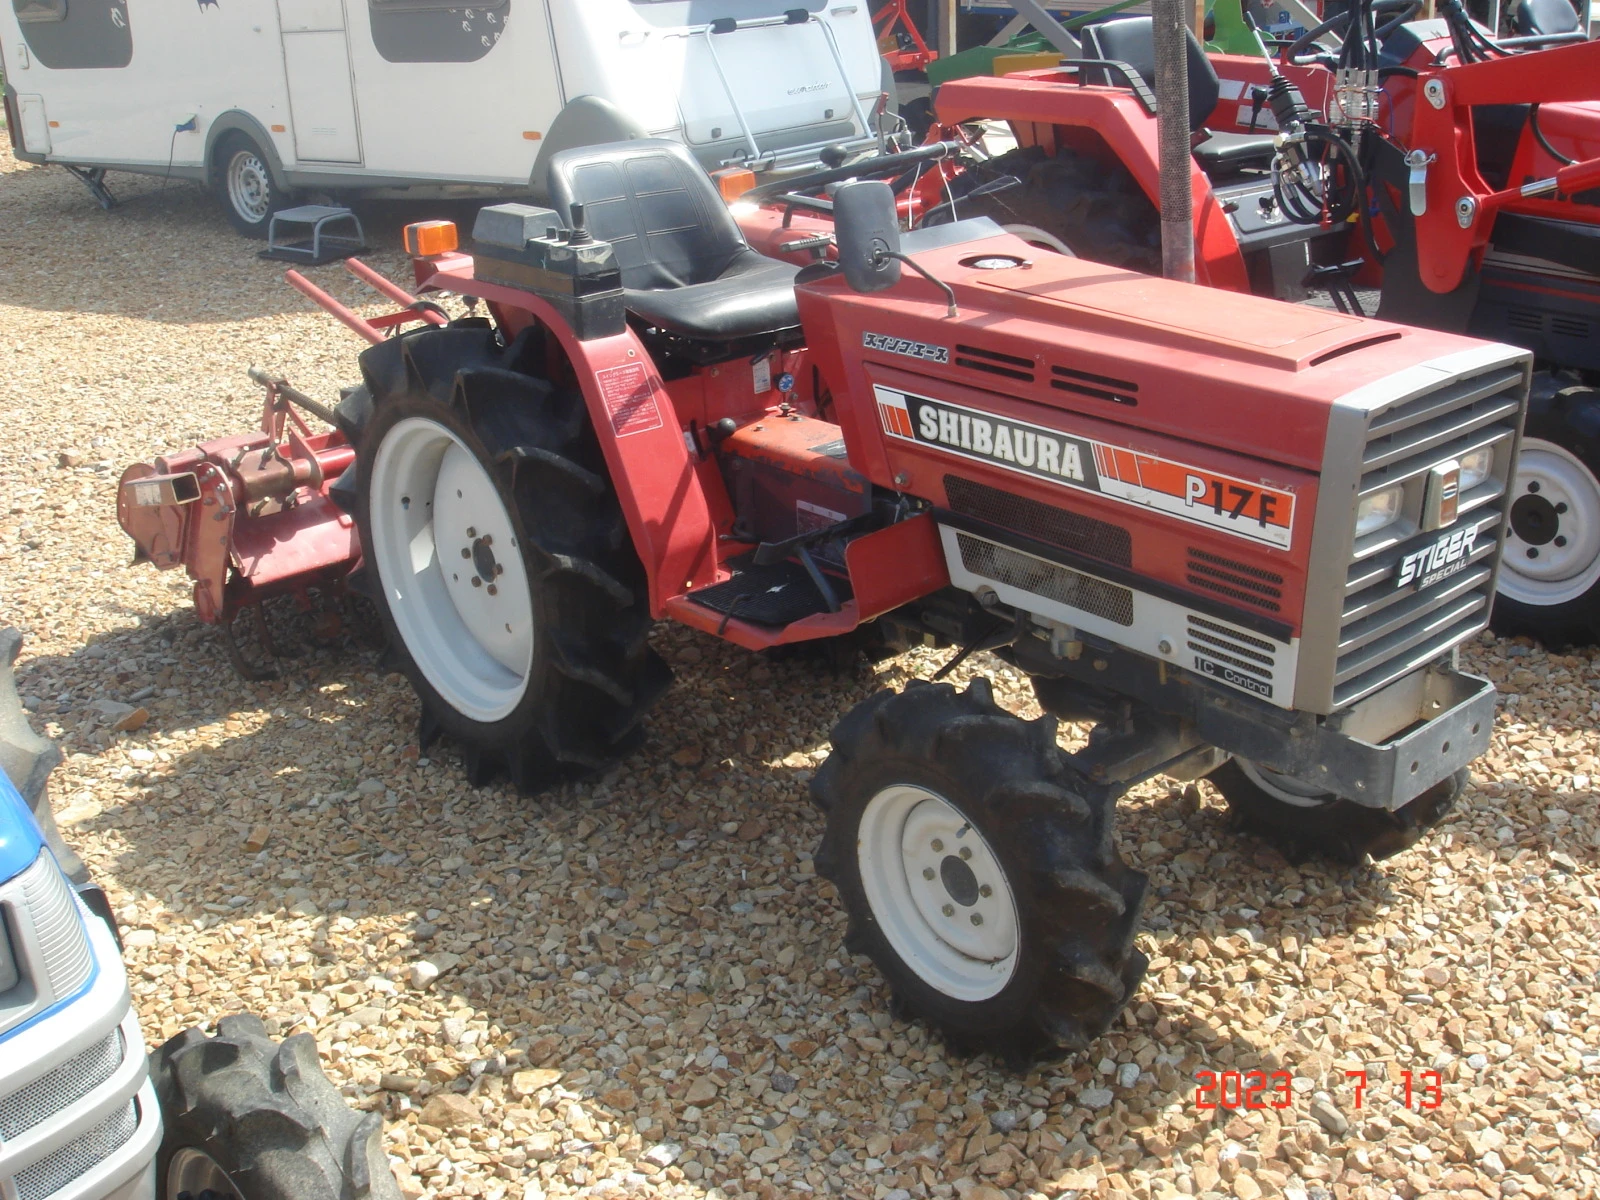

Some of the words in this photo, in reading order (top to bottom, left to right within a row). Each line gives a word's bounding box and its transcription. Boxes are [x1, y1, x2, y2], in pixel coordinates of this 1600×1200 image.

[918, 405, 1085, 482] SHIBAURA
[1184, 473, 1278, 529] P17F
[1397, 524, 1479, 588] STIGER
[1421, 557, 1467, 588] SPECIAL
[1224, 669, 1270, 696] Control
